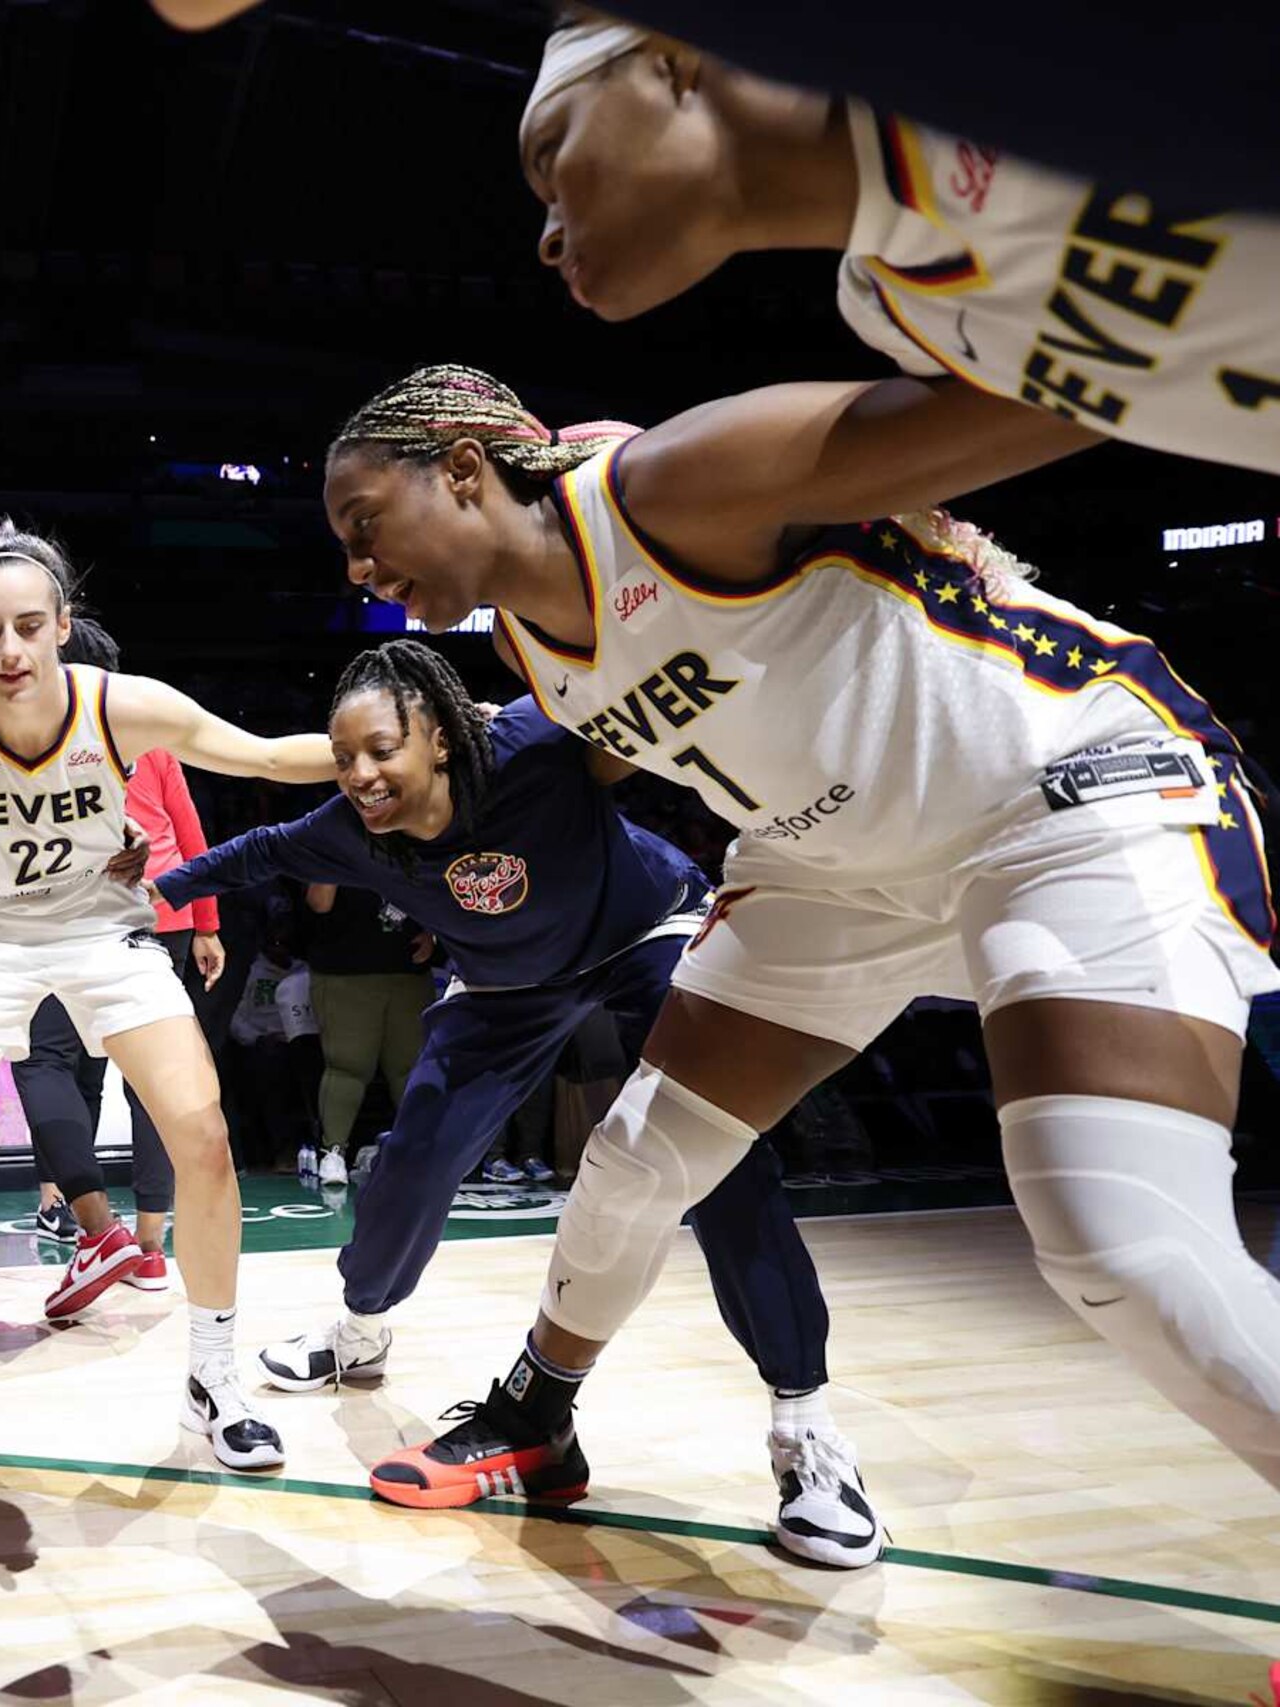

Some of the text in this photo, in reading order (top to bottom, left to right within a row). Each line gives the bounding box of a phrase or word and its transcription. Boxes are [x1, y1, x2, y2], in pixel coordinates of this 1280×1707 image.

[1163, 519, 1265, 551] INDIANA
[614, 582, 658, 621] Lilly
[68, 750, 105, 768] Lilly
[672, 745, 762, 812] 1
[9, 837, 74, 886] 22
